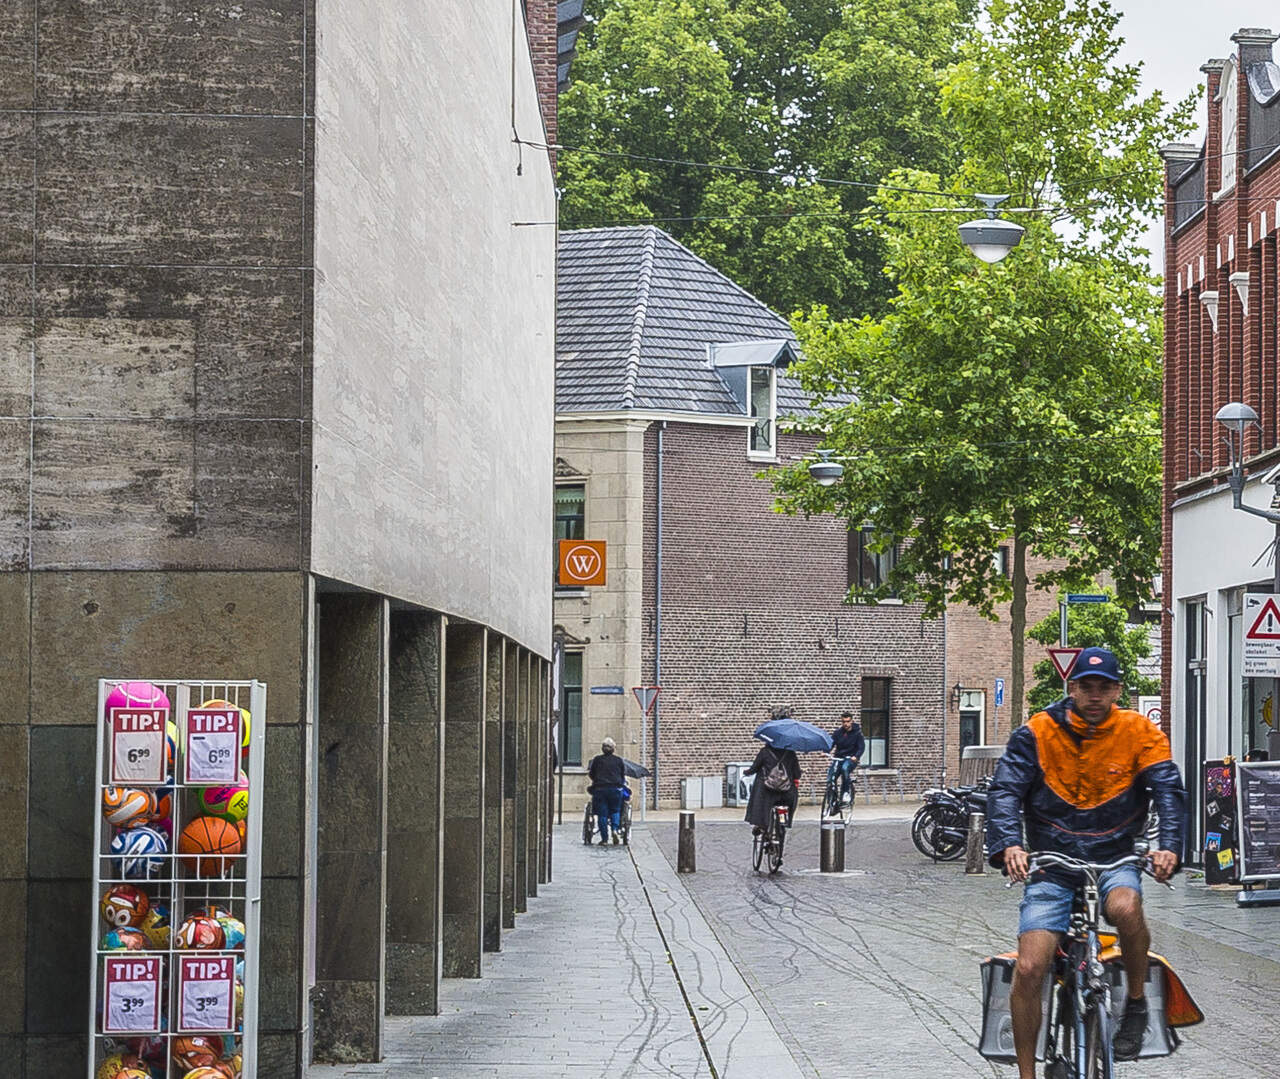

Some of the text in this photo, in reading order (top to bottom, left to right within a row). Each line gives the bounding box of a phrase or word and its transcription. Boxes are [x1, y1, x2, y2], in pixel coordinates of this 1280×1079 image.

[571, 555, 595, 574] W
[118, 711, 160, 731] TIP!
[192, 712, 234, 732] TIP!
[112, 960, 154, 980] TIP!
[186, 959, 228, 979] TIP!
